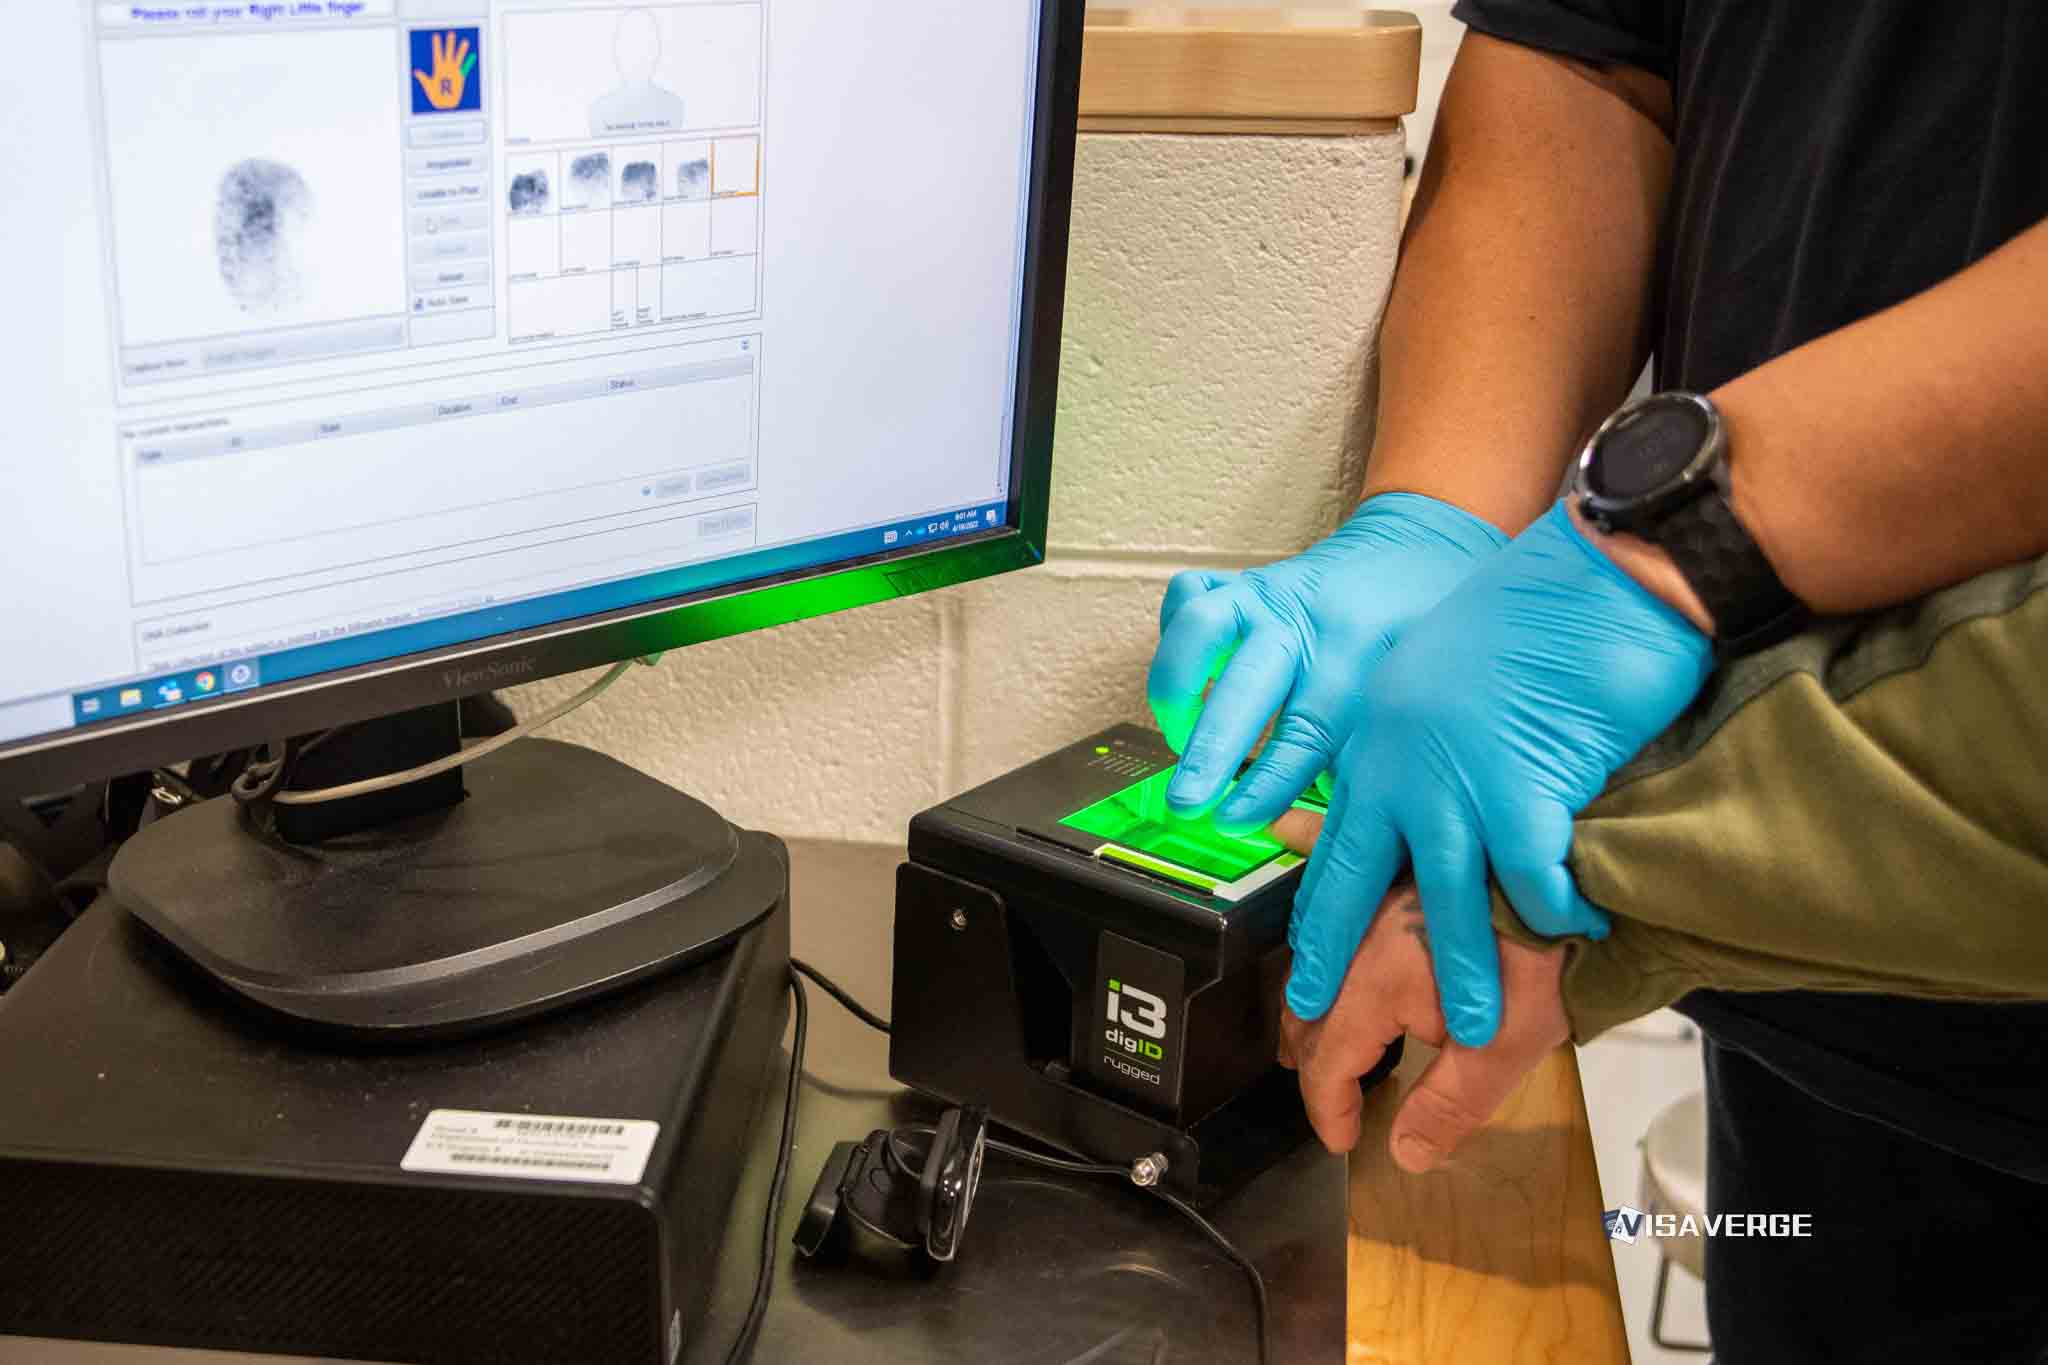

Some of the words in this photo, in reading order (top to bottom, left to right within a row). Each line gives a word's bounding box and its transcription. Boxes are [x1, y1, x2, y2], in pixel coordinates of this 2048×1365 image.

[249, 3, 286, 20] Right
[290, 3, 323, 17] Little
[327, 1, 365, 17] finger
[439, 79, 453, 97] R
[442, 656, 537, 688] ViewSonic
[1106, 978, 1167, 1039] i3
[1105, 1028, 1164, 1060] digID
[1103, 1055, 1161, 1085] rugged
